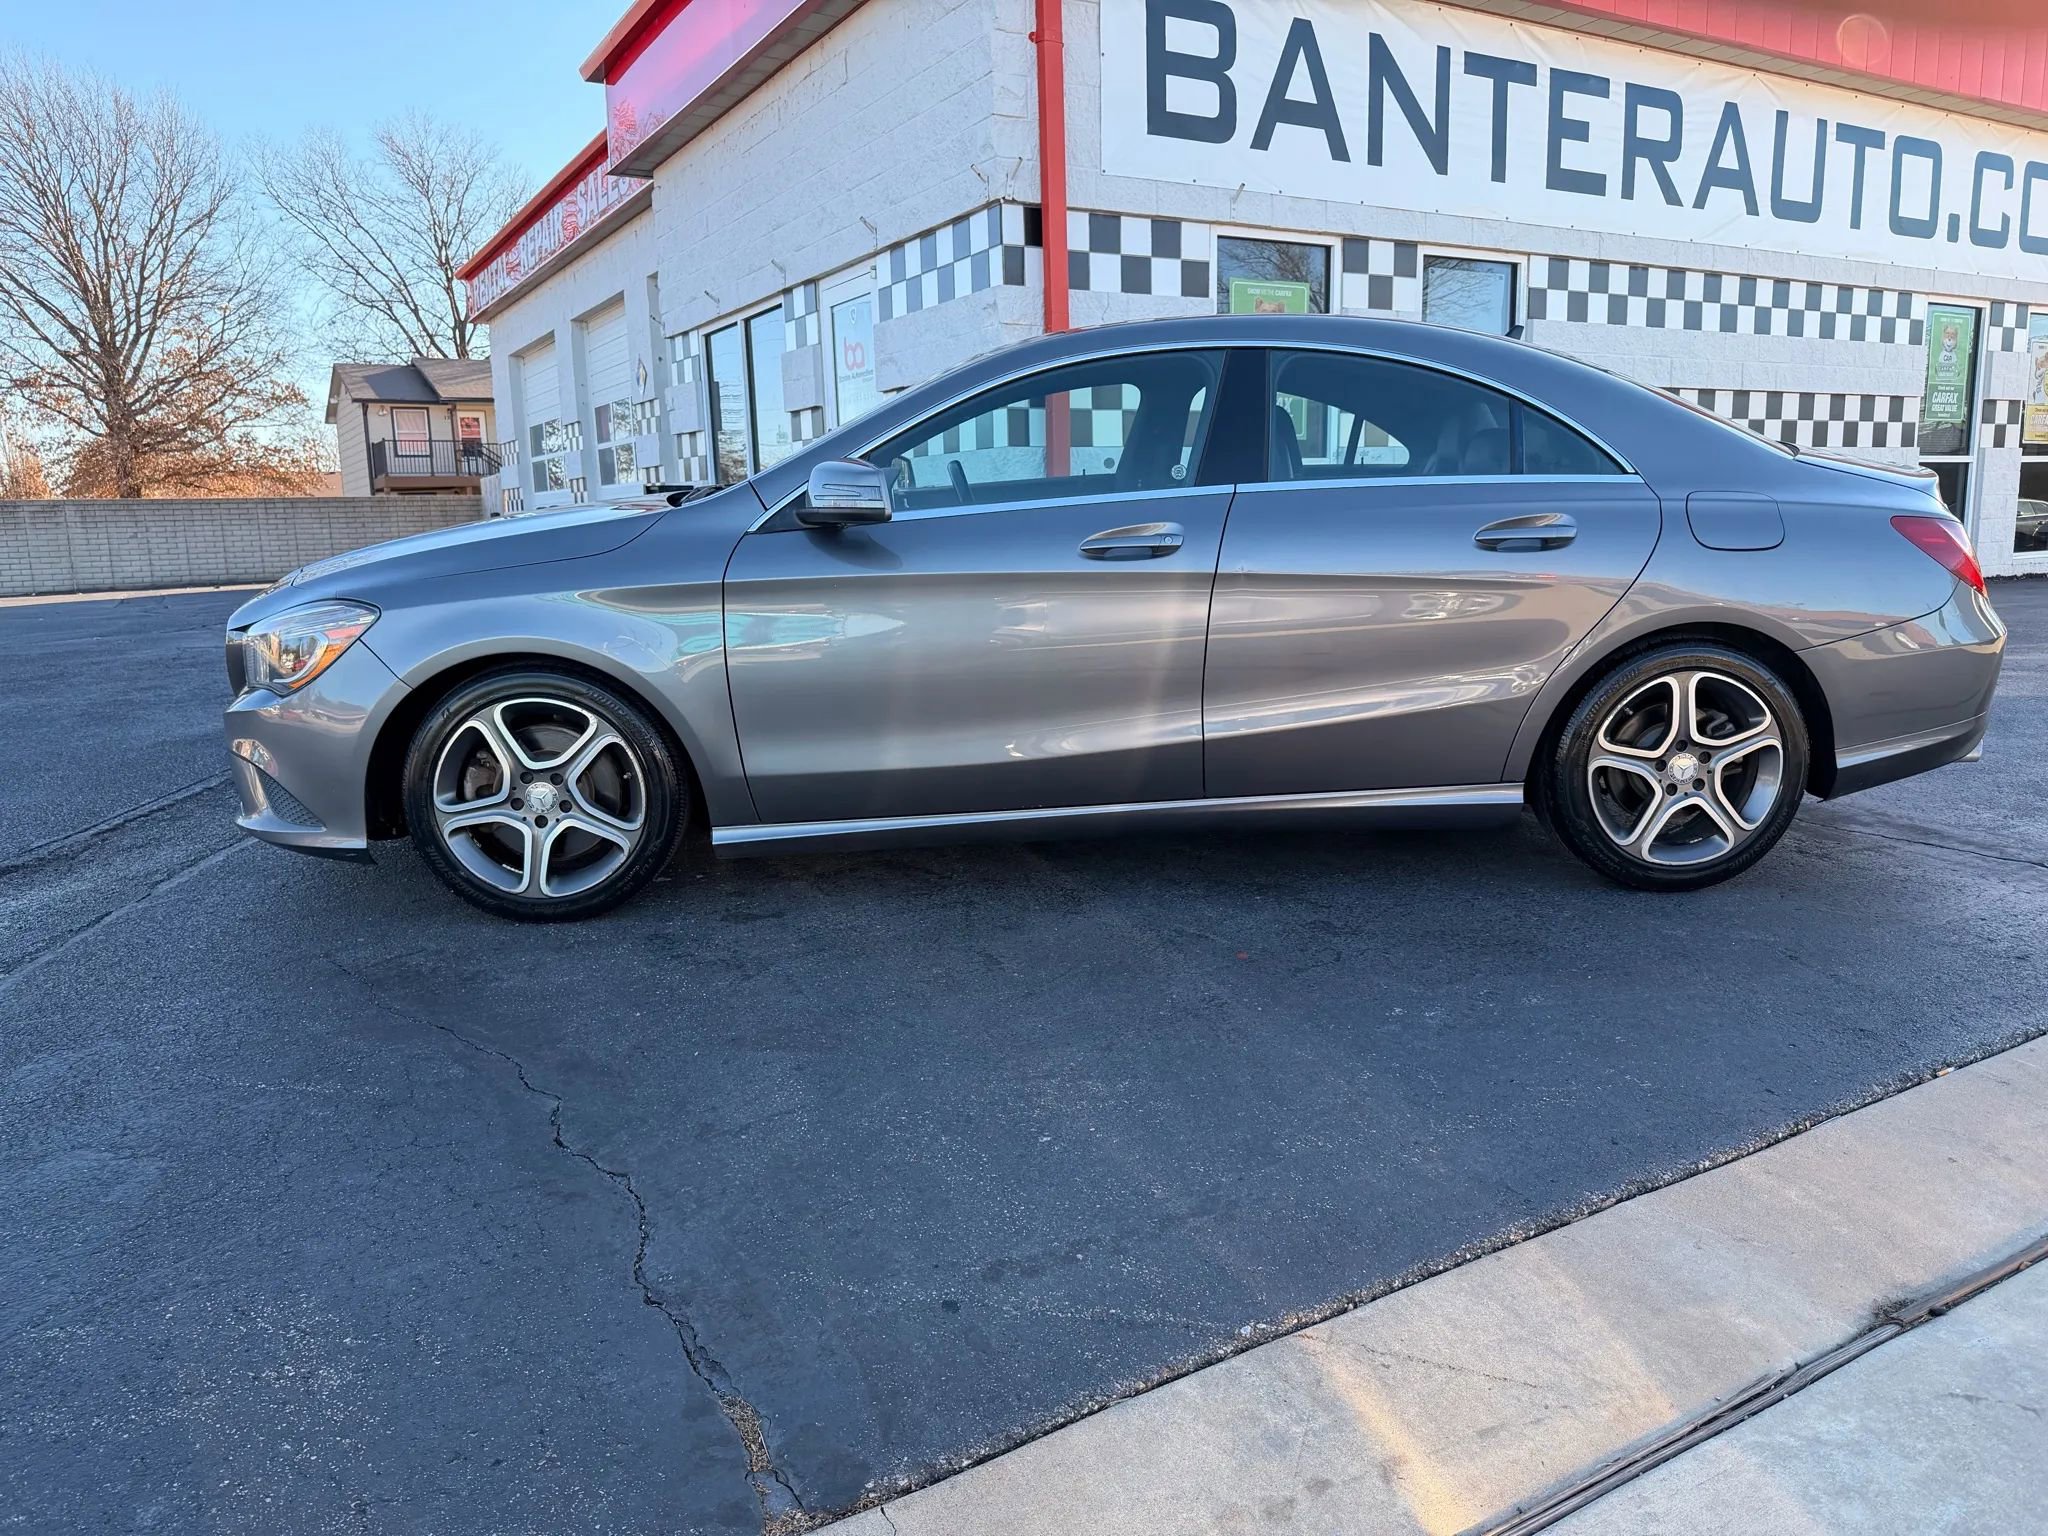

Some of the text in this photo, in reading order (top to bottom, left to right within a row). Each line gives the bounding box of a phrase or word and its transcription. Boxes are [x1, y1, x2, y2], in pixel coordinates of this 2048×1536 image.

[1145, 0, 2048, 256] BANTERAUTO.CO
[520, 203, 564, 275] REPAIR
[1932, 391, 1959, 404] CARFAX
